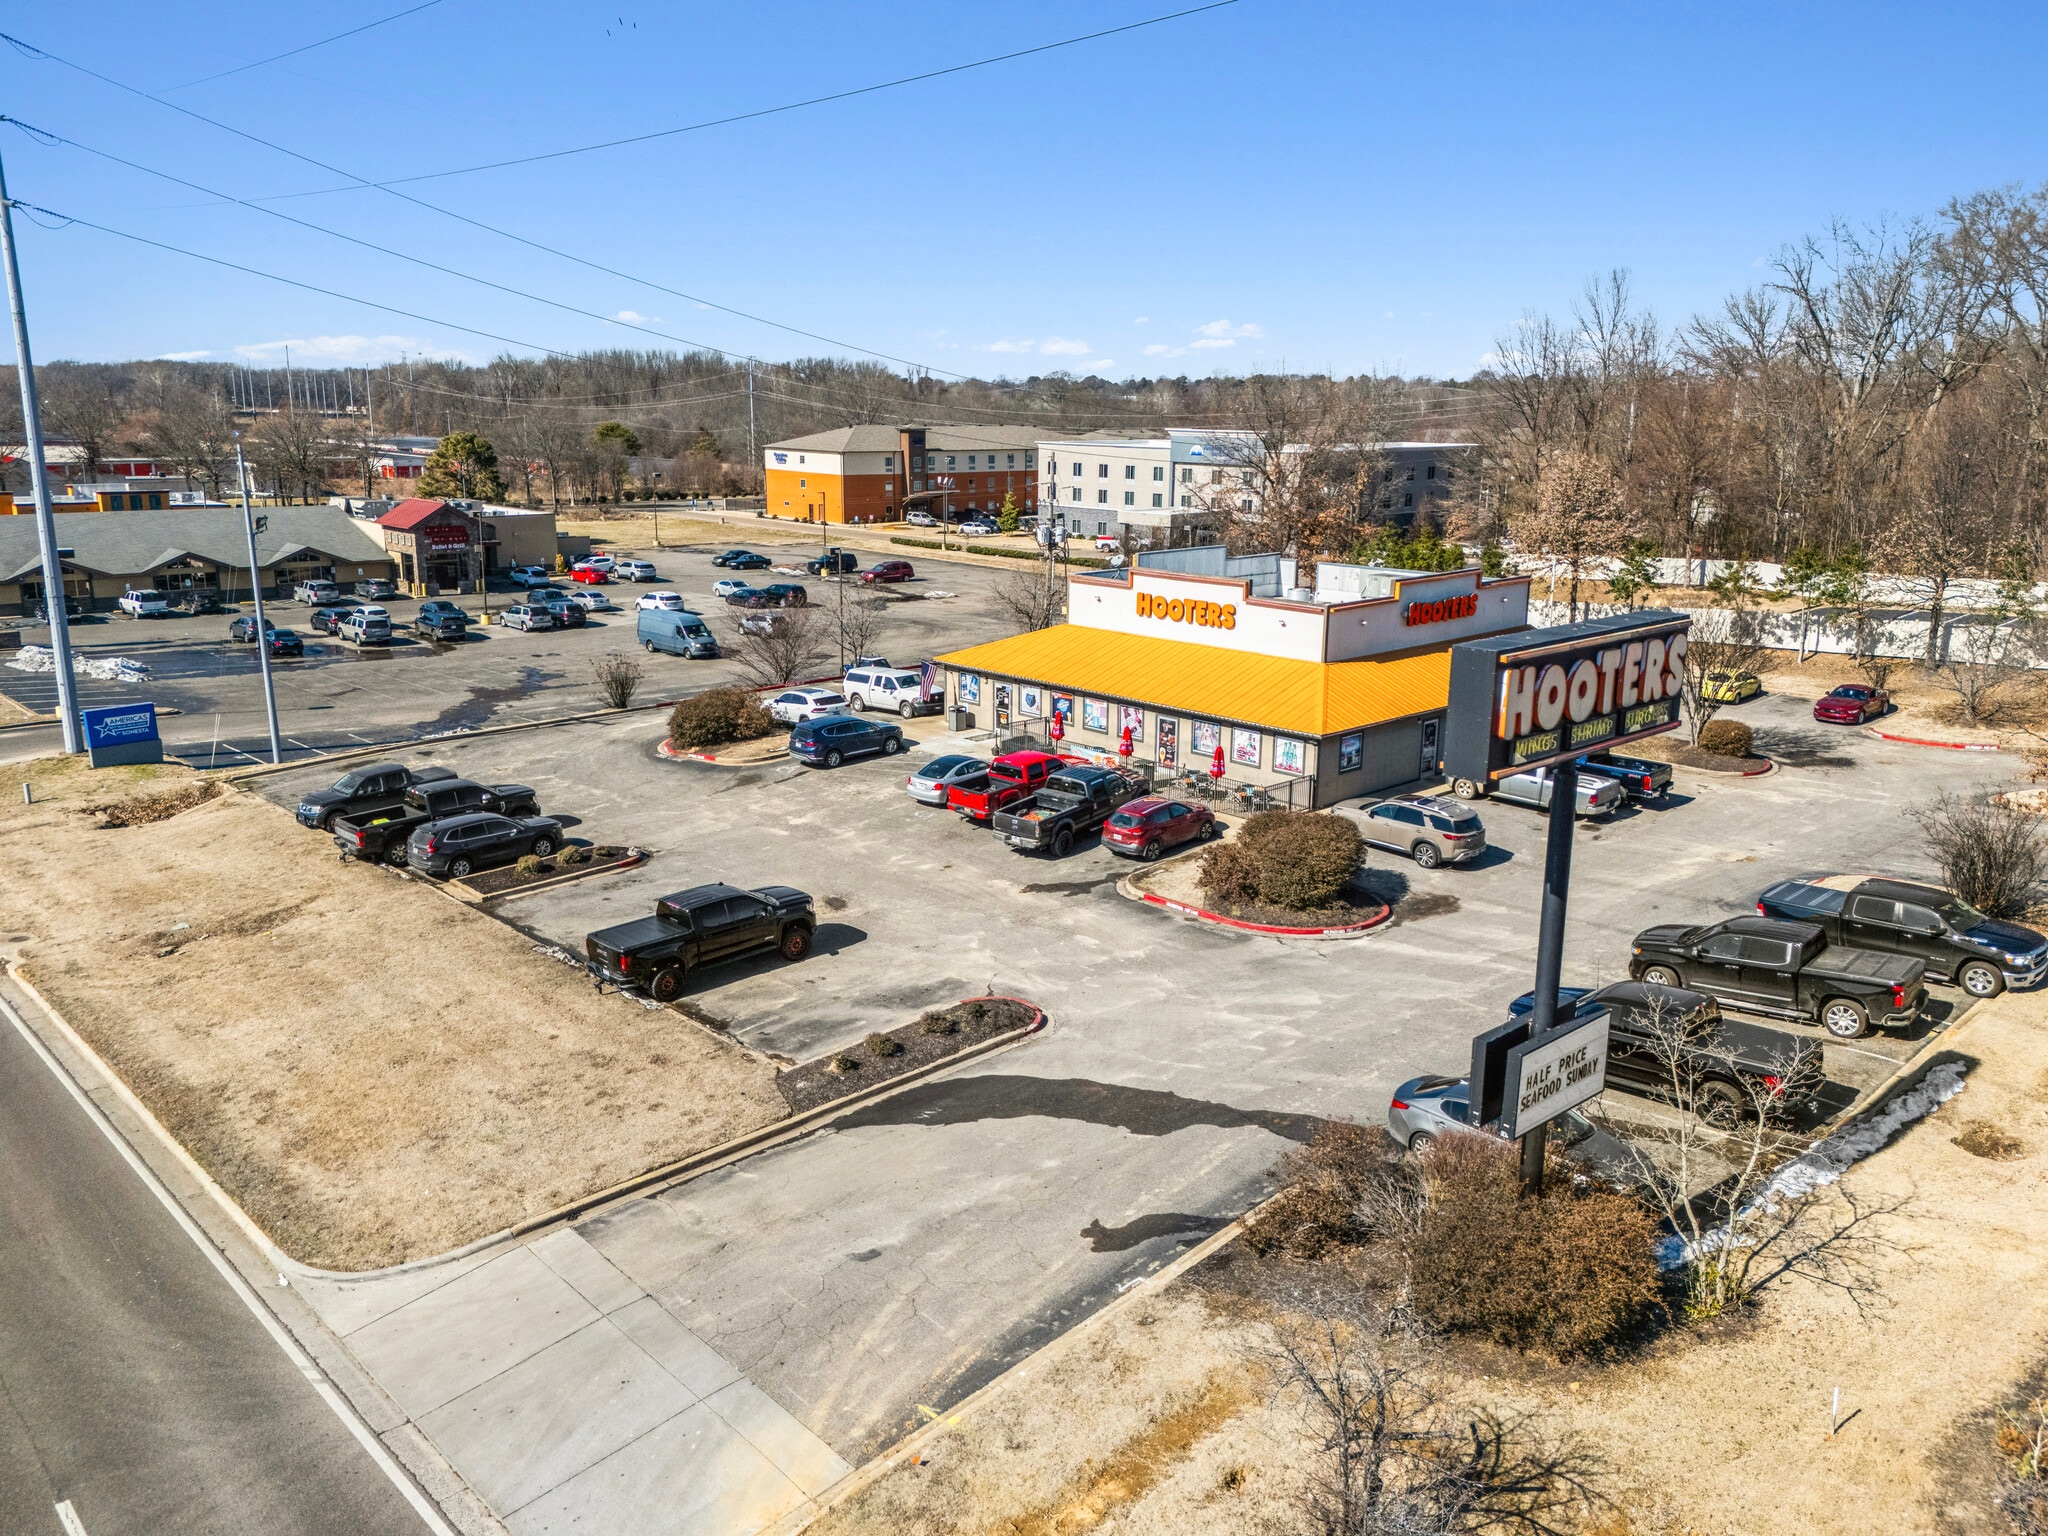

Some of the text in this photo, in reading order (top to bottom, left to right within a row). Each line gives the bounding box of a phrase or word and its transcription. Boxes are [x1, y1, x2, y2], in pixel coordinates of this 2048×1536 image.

[1136, 592, 1236, 630] HOOTERS
[1407, 593, 1479, 627] HOOTERS
[1499, 633, 1688, 741] HOOTERS
[109, 714, 148, 725] AMERICAS
[1571, 718, 1613, 744] SHRIMP
[1516, 733, 1558, 756] WINGS
[1520, 1057, 1599, 1112] SEAFOOD SUNDAY
[1526, 1046, 1587, 1091] HALF PRICE
